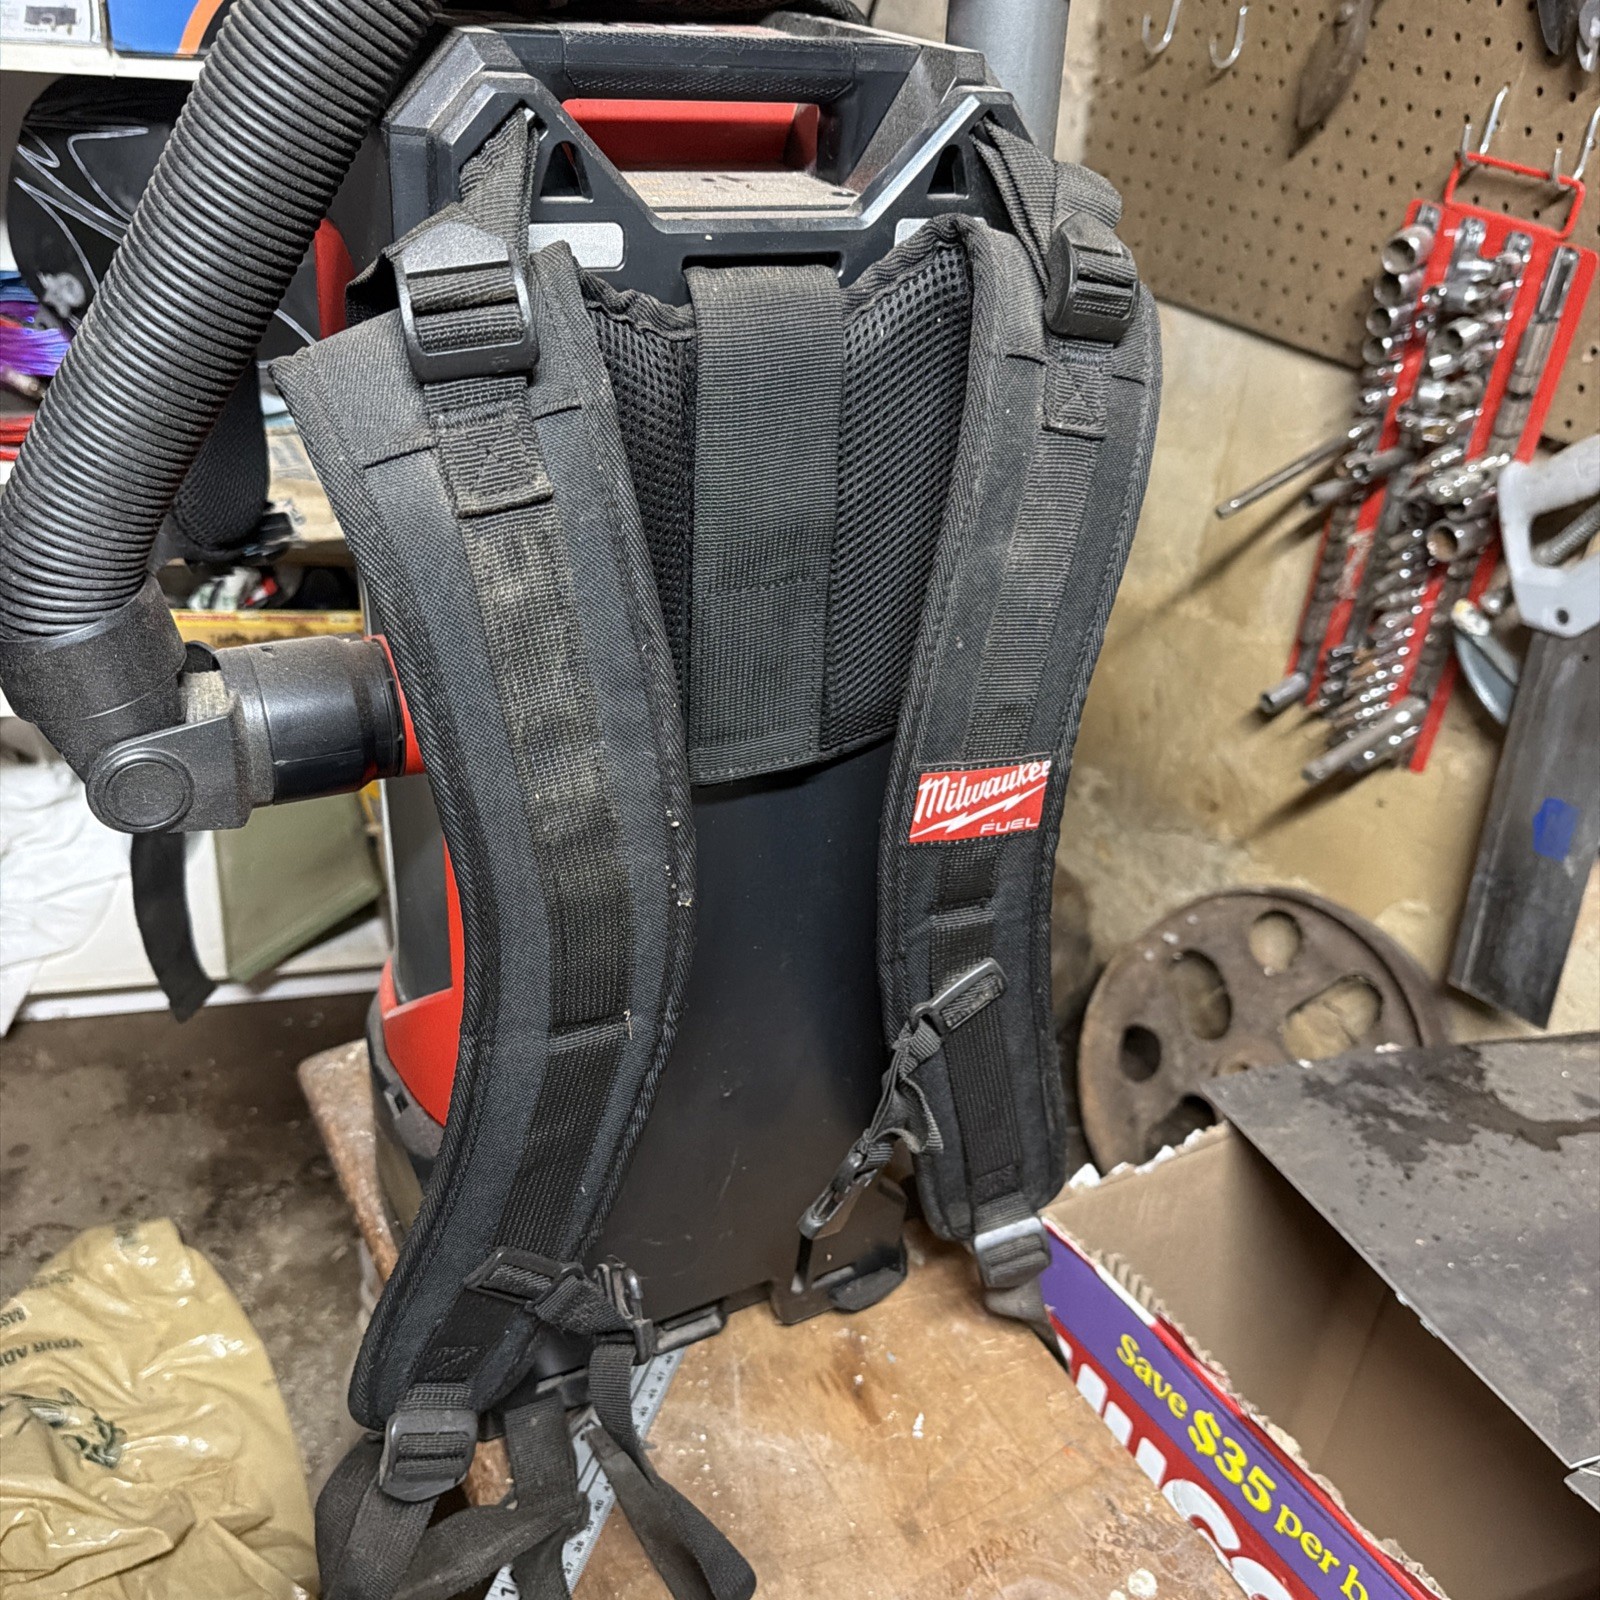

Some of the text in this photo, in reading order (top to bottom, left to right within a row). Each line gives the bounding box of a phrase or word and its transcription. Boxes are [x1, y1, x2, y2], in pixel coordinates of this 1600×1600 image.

[913, 759, 1052, 825] Milwaukee
[979, 817, 1039, 834] FUEL
[33, 1338, 83, 1354] YOUR
[1115, 1332, 1190, 1420] Save
[1187, 1409, 1278, 1515] $35
[1273, 1502, 1341, 1575] per
